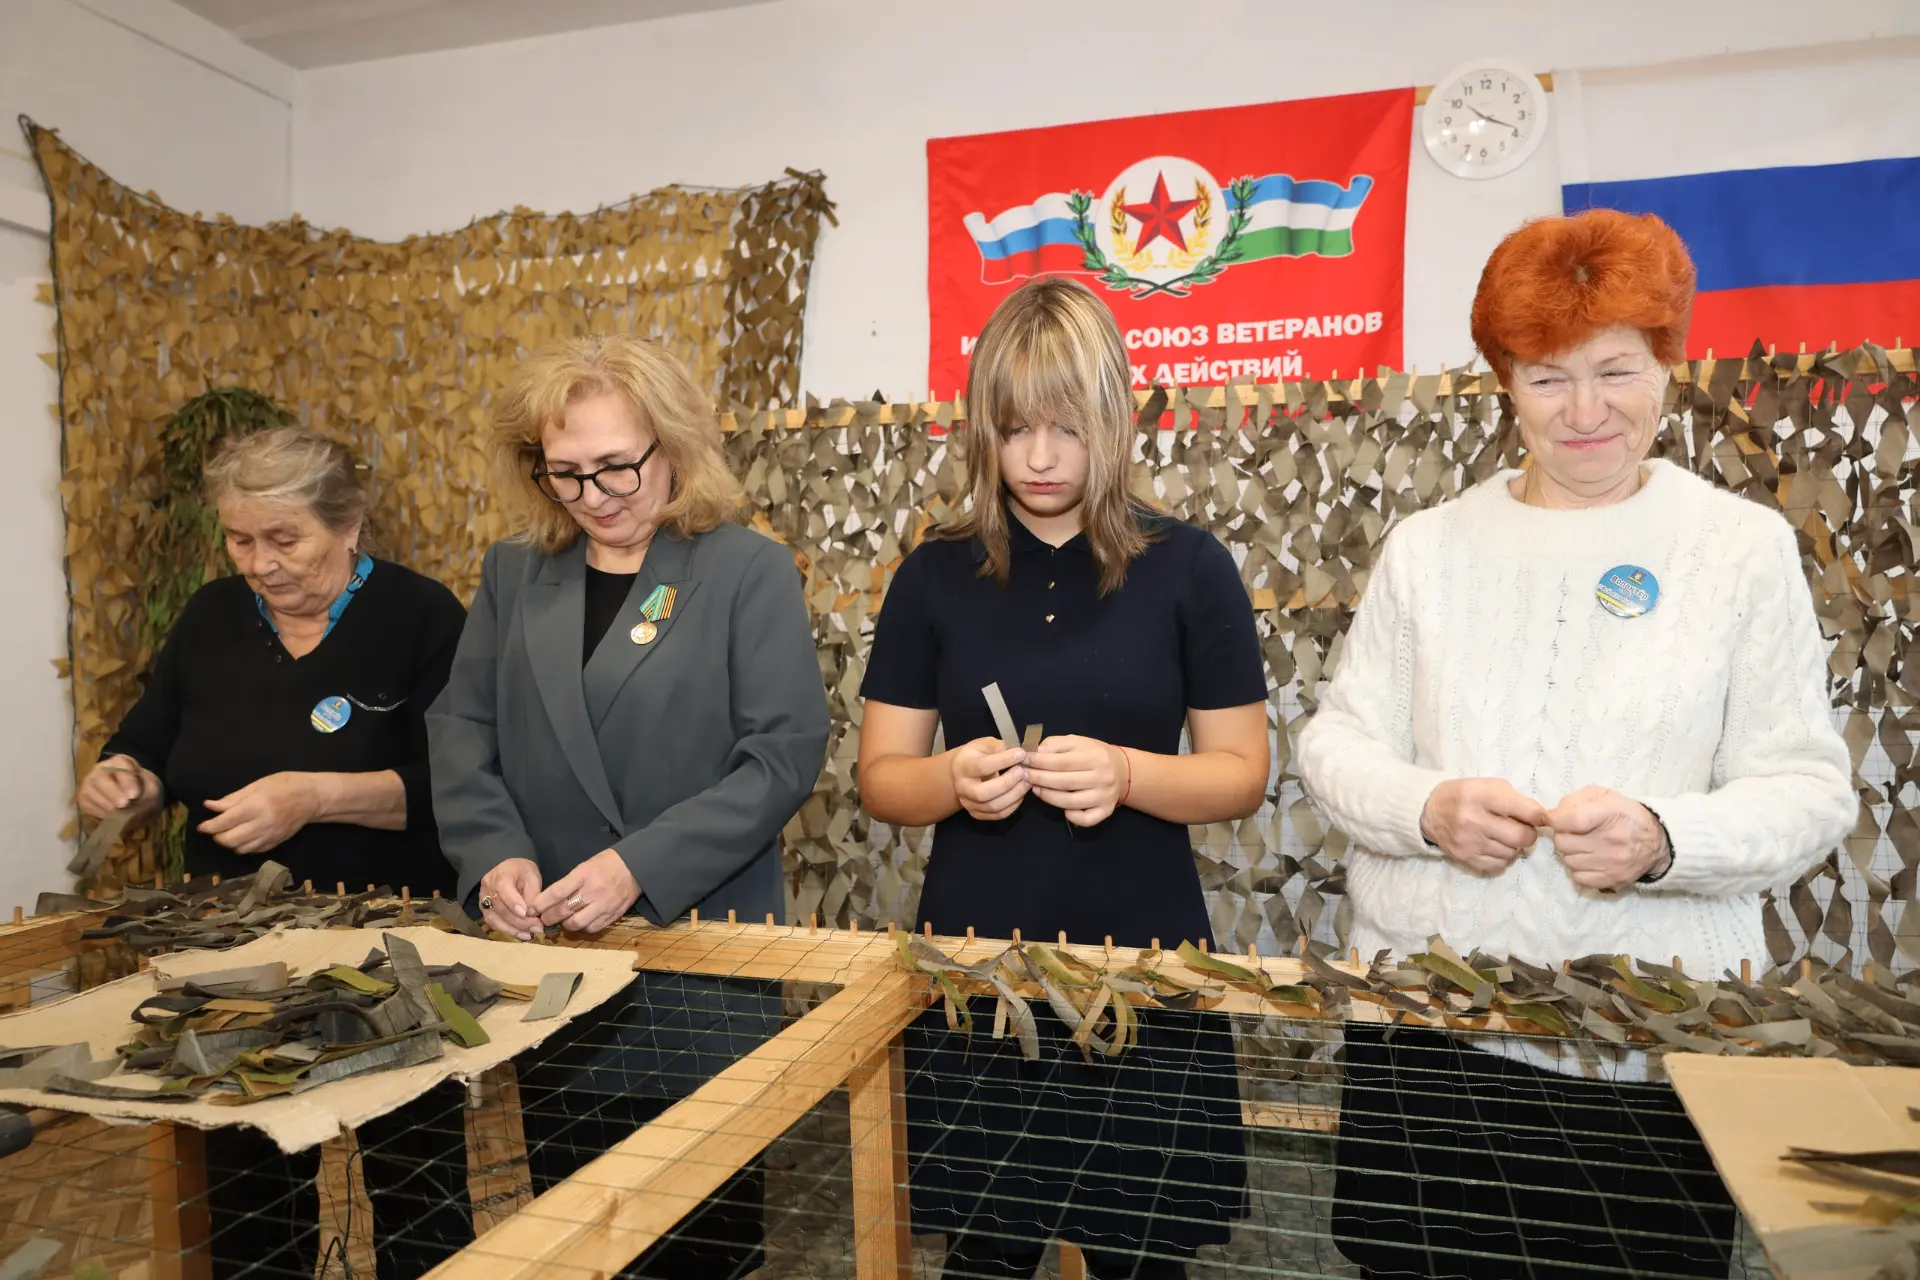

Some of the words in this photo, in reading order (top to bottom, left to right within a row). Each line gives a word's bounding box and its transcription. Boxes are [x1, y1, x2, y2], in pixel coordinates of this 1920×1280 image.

[1480, 79, 1492, 90] 12
[1463, 86, 1473, 96] 11
[1451, 98, 1463, 109] 10
[1512, 94, 1521, 104] 2
[1517, 110, 1526, 120] 3
[1444, 116, 1452, 127] 9
[1511, 128, 1519, 138] 4
[1464, 144, 1471, 155] 7
[1499, 141, 1506, 151] 5
[1479, 148, 1488, 158] 6
[1125, 325, 1209, 350] СОЮЗ
[1216, 311, 1383, 344] ВЕТЕРАНОВ
[1155, 349, 1303, 387] ДЕЙСТВИЙ
